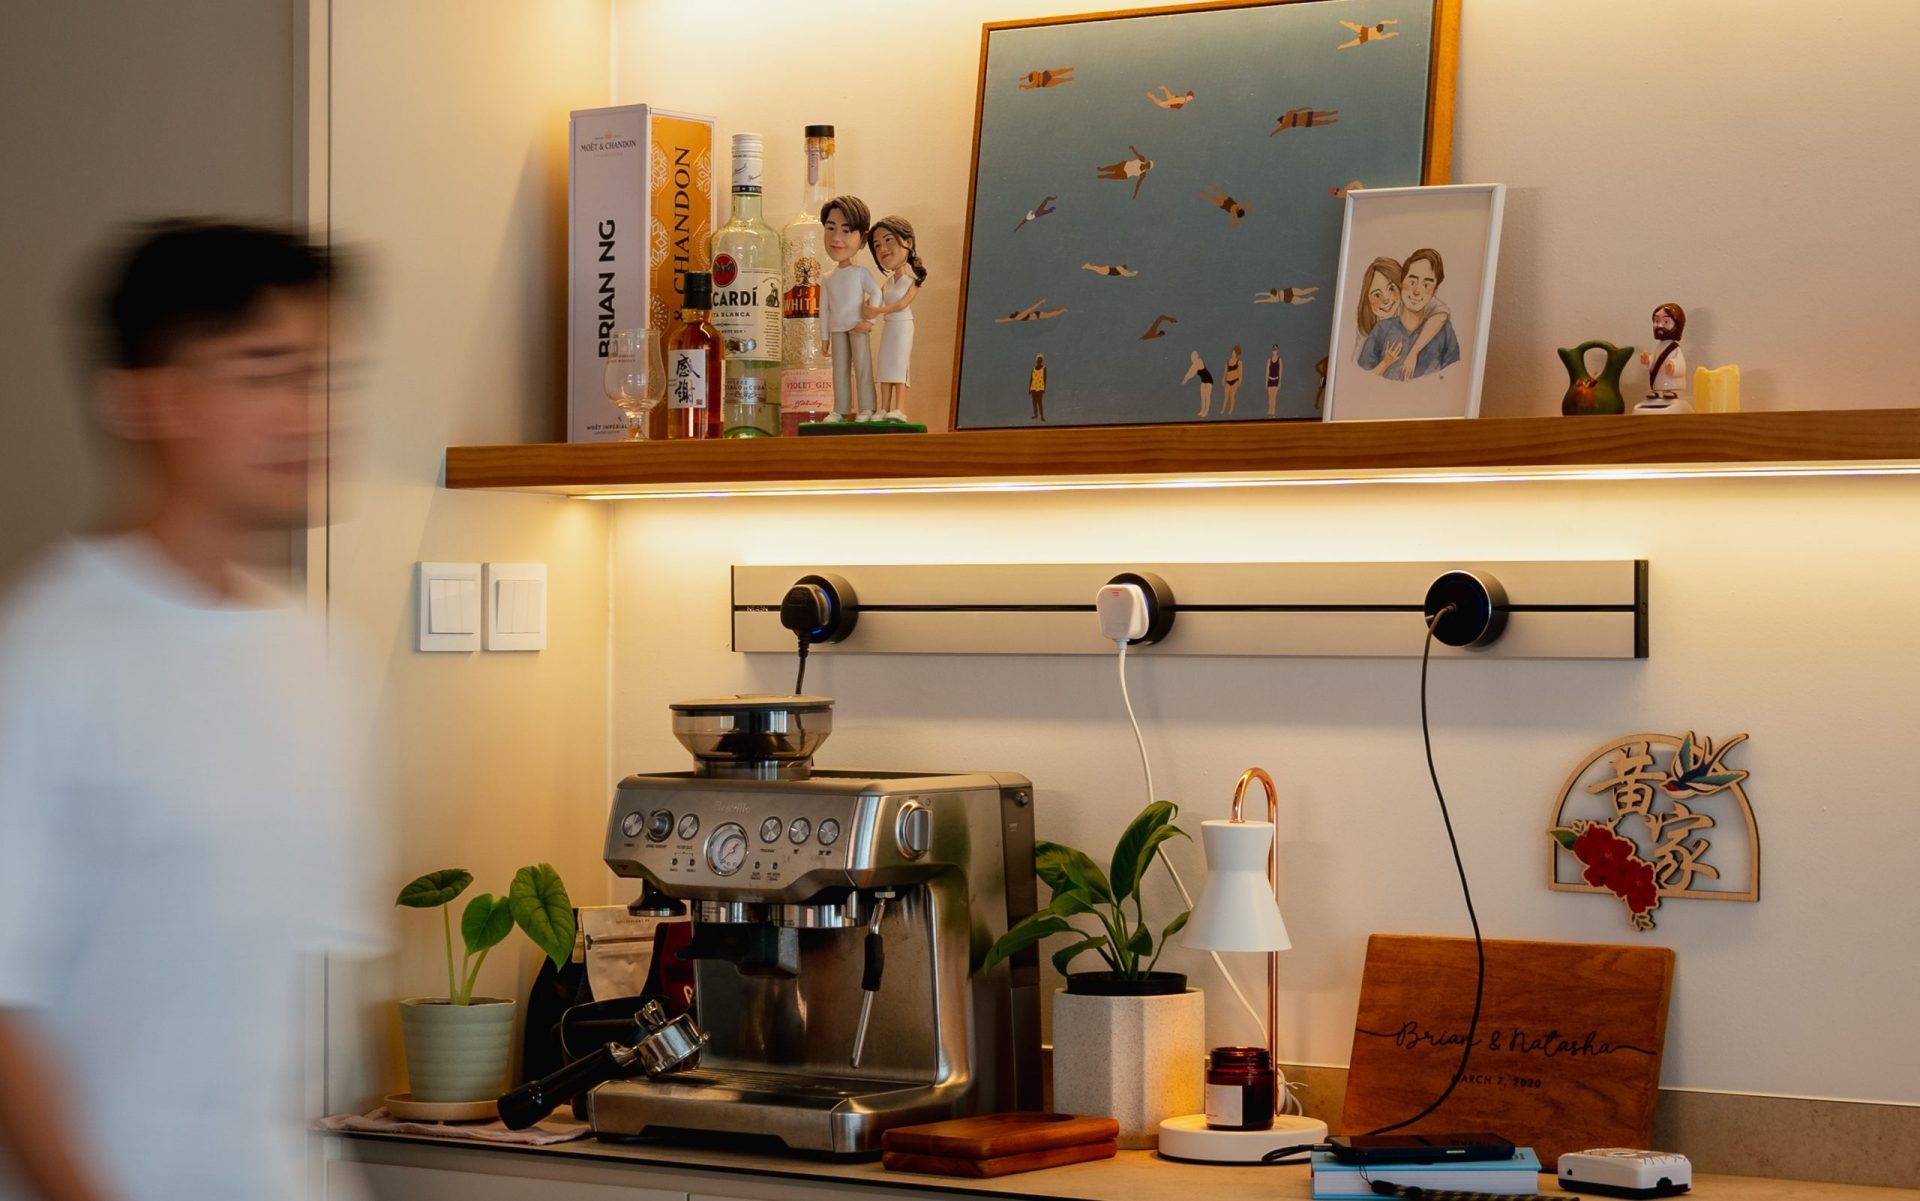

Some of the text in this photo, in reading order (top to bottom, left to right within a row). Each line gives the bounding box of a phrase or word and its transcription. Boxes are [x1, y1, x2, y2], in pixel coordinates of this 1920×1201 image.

[605, 139, 637, 150] CHANDON
[673, 146, 691, 295] CHANDON
[598, 219, 616, 358] BRIAN NG
[712, 286, 758, 307] CARDÍ
[783, 297, 821, 311] WHITL
[815, 381, 832, 390] GIN
[1395, 1021, 1616, 1058] Brian & Natasha
